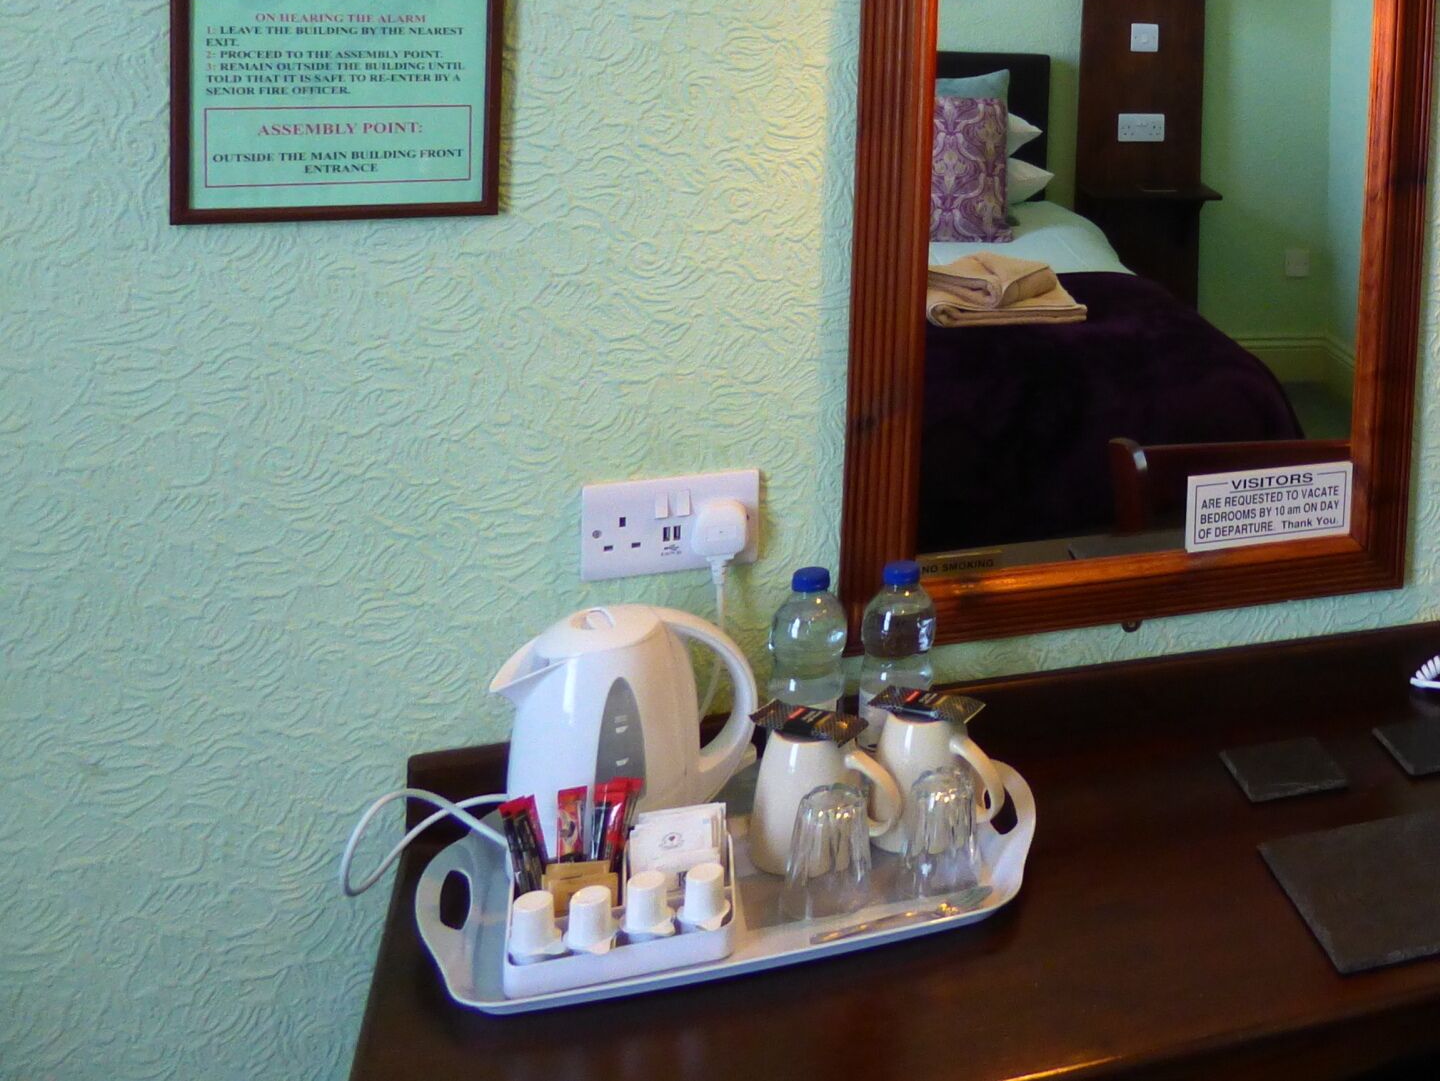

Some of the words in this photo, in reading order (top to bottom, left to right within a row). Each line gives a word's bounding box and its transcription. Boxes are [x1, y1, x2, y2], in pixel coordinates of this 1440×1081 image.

[255, 13, 276, 22] ON
[280, 13, 343, 23] HEARING
[348, 14, 372, 23] THE
[378, 14, 427, 23] ALARM
[220, 26, 263, 35] LEAVE
[266, 26, 292, 35] THE
[296, 26, 358, 35] BUILDING
[361, 26, 379, 35] BY
[381, 27, 405, 36] THE
[409, 27, 464, 36] NEAREST
[206, 38, 240, 47] EXIT.
[220, 50, 282, 59] PROCEED
[286, 50, 303, 59] TO
[307, 50, 333, 59] THE
[335, 50, 400, 59] ASSEMBLY
[404, 50, 443, 59] POINT.
[220, 62, 273, 71] REMAIN
[276, 62, 331, 71] OUTSIDE
[337, 62, 360, 71] THE
[365, 61, 425, 71] BUILDING
[428, 61, 465, 70] UNTIL
[206, 74, 242, 84] TOLD
[246, 74, 280, 83] THAT
[283, 74, 297, 83] IT
[300, 74, 312, 83] IS
[314, 74, 346, 83] SAFE
[350, 74, 366, 83] TO
[370, 73, 431, 83] RE-ENTER
[434, 73, 450, 82] BY
[453, 73, 462, 82] A
[205, 86, 255, 96] SENIOR
[259, 86, 289, 96] FIRE
[292, 86, 351, 95] OFFICER.
[258, 122, 358, 137] ASSEMBLY
[363, 122, 424, 134] POINT:
[212, 152, 276, 163] OUTSIDE
[277, 152, 307, 162] THE
[311, 150, 347, 161] MAIN
[351, 149, 417, 160] BUILDING
[420, 148, 464, 159] FRONT
[304, 163, 379, 175] ENTRANCE
[1231, 472, 1313, 490] VISITORS
[1201, 498, 1221, 510] ARE
[1224, 491, 1284, 507] REQUESTED
[1286, 489, 1299, 501] TO
[1301, 485, 1340, 499] VACATE
[1200, 508, 1257, 525] BEDROOMS
[1259, 506, 1272, 518] BY
[1275, 505, 1285, 517] 10
[1287, 506, 1301, 515] am
[1303, 502, 1318, 513] ON
[1320, 499, 1340, 511] DAY
[1198, 527, 1211, 540] OF
[1281, 516, 1313, 530] Thank
[921, 564, 938, 575] NO
[942, 559, 995, 573] SMOKING
